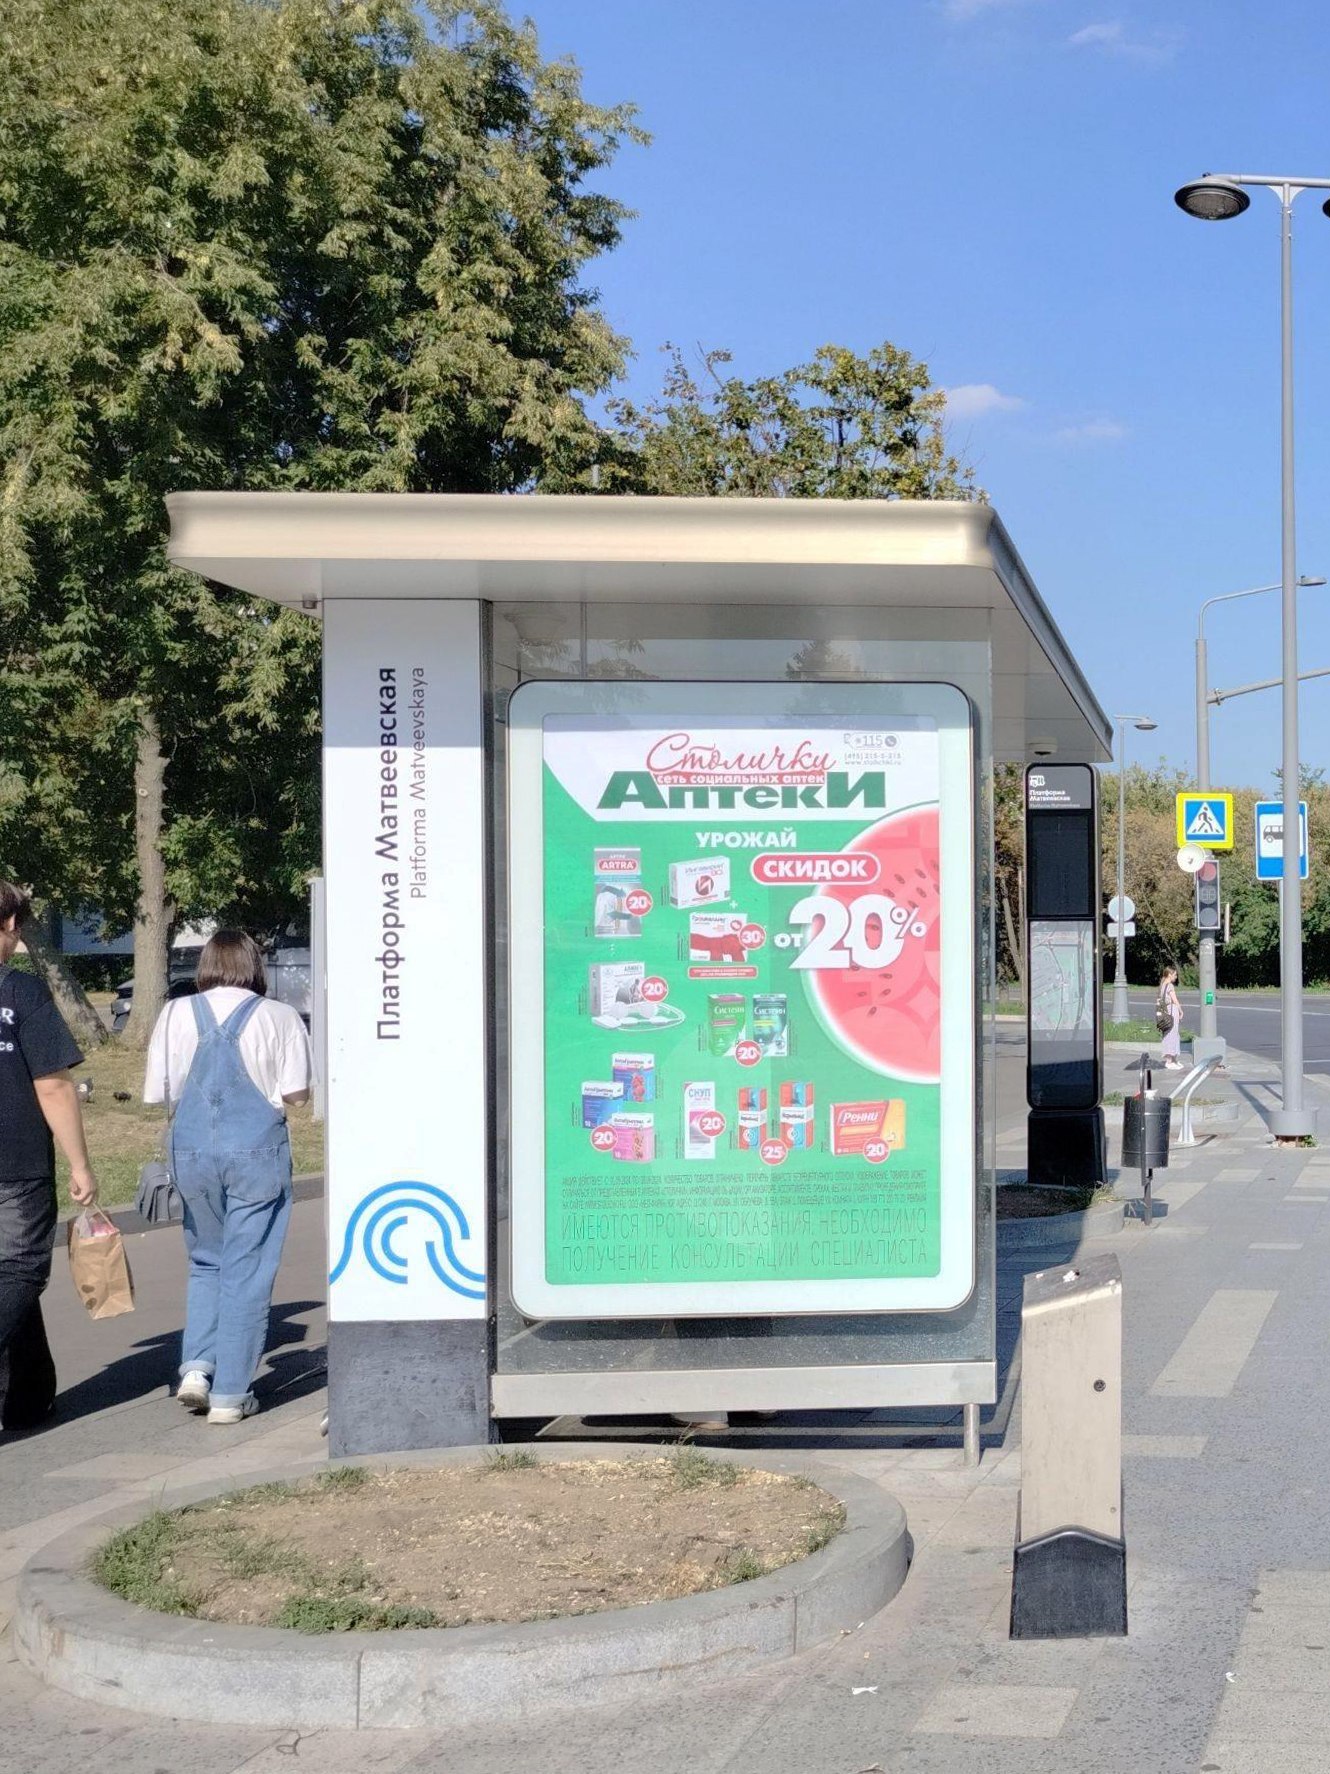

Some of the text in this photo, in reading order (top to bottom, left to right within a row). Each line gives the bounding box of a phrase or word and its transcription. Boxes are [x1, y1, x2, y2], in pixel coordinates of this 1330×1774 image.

[646, 733, 837, 773] Столички
[408, 666, 430, 899] Platforma Matveevskaya
[657, 774, 825, 786] сеть социальных аптек
[695, 827, 797, 848] УРОЖАЙ
[374, 667, 405, 1041] Платформа Матвеевская
[602, 861, 634, 870] ARTRA
[763, 859, 868, 881] СКИДОК
[774, 933, 804, 948] от
[688, 1088, 711, 1098] СНУП
[842, 1110, 879, 1124] Ренни
[562, 1212, 639, 1240] ИМЕЮТСЯ
[562, 1237, 928, 1272] ПОЛУЧЕНИЕ КОНСУЛЬТАЦИИ СПЕЦИАЛИСТА
